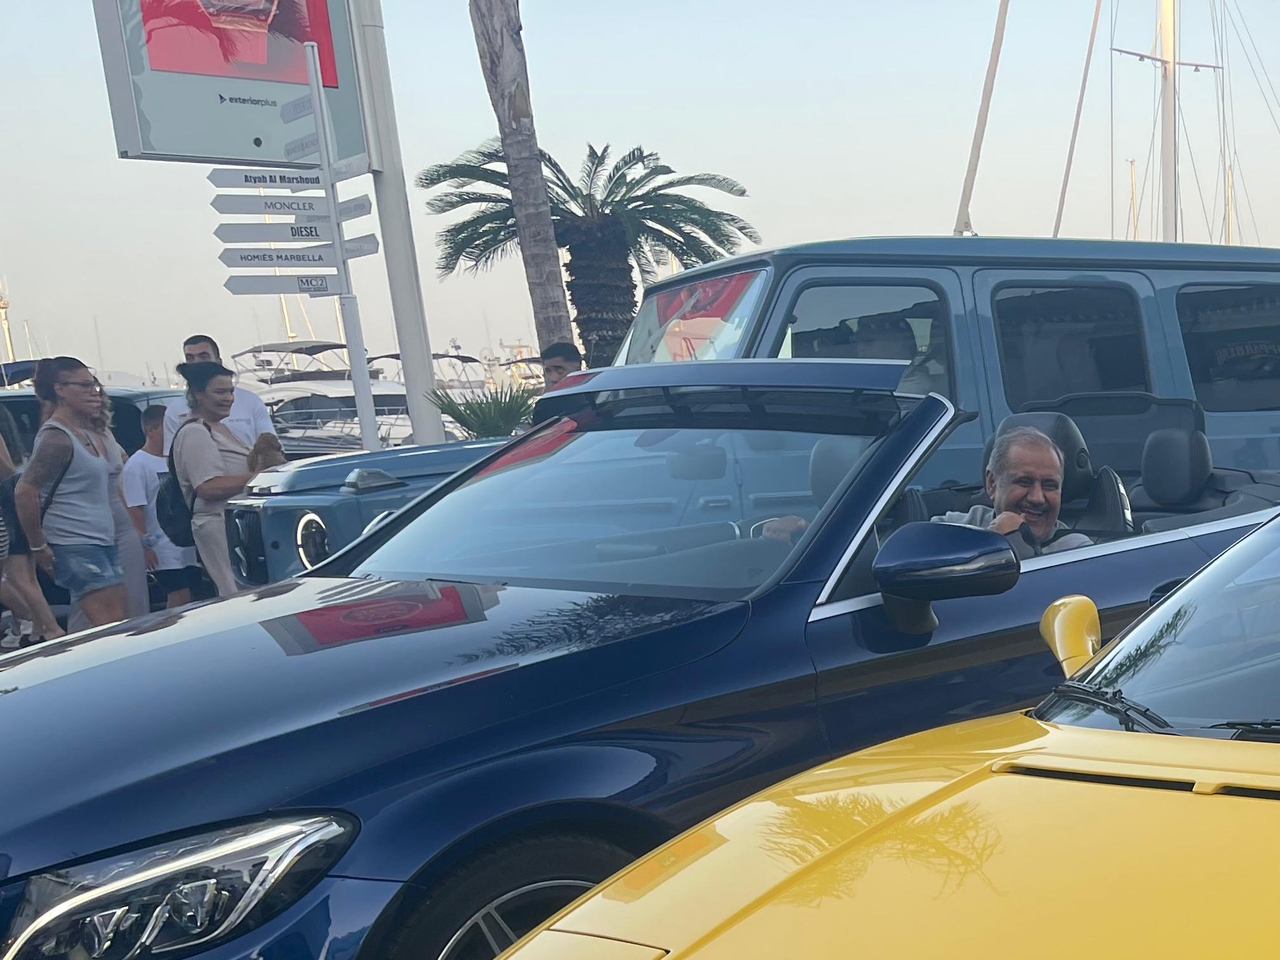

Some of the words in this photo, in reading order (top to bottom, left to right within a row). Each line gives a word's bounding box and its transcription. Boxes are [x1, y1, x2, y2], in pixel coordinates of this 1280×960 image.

[229, 96, 278, 108] exteriorplus
[244, 174, 267, 184] Atyab
[269, 175, 277, 184] Al
[279, 175, 320, 185] Marshoud
[264, 201, 315, 211] MONCLER
[290, 226, 320, 238] DIESEL
[276, 254, 324, 262] MARBELLA
